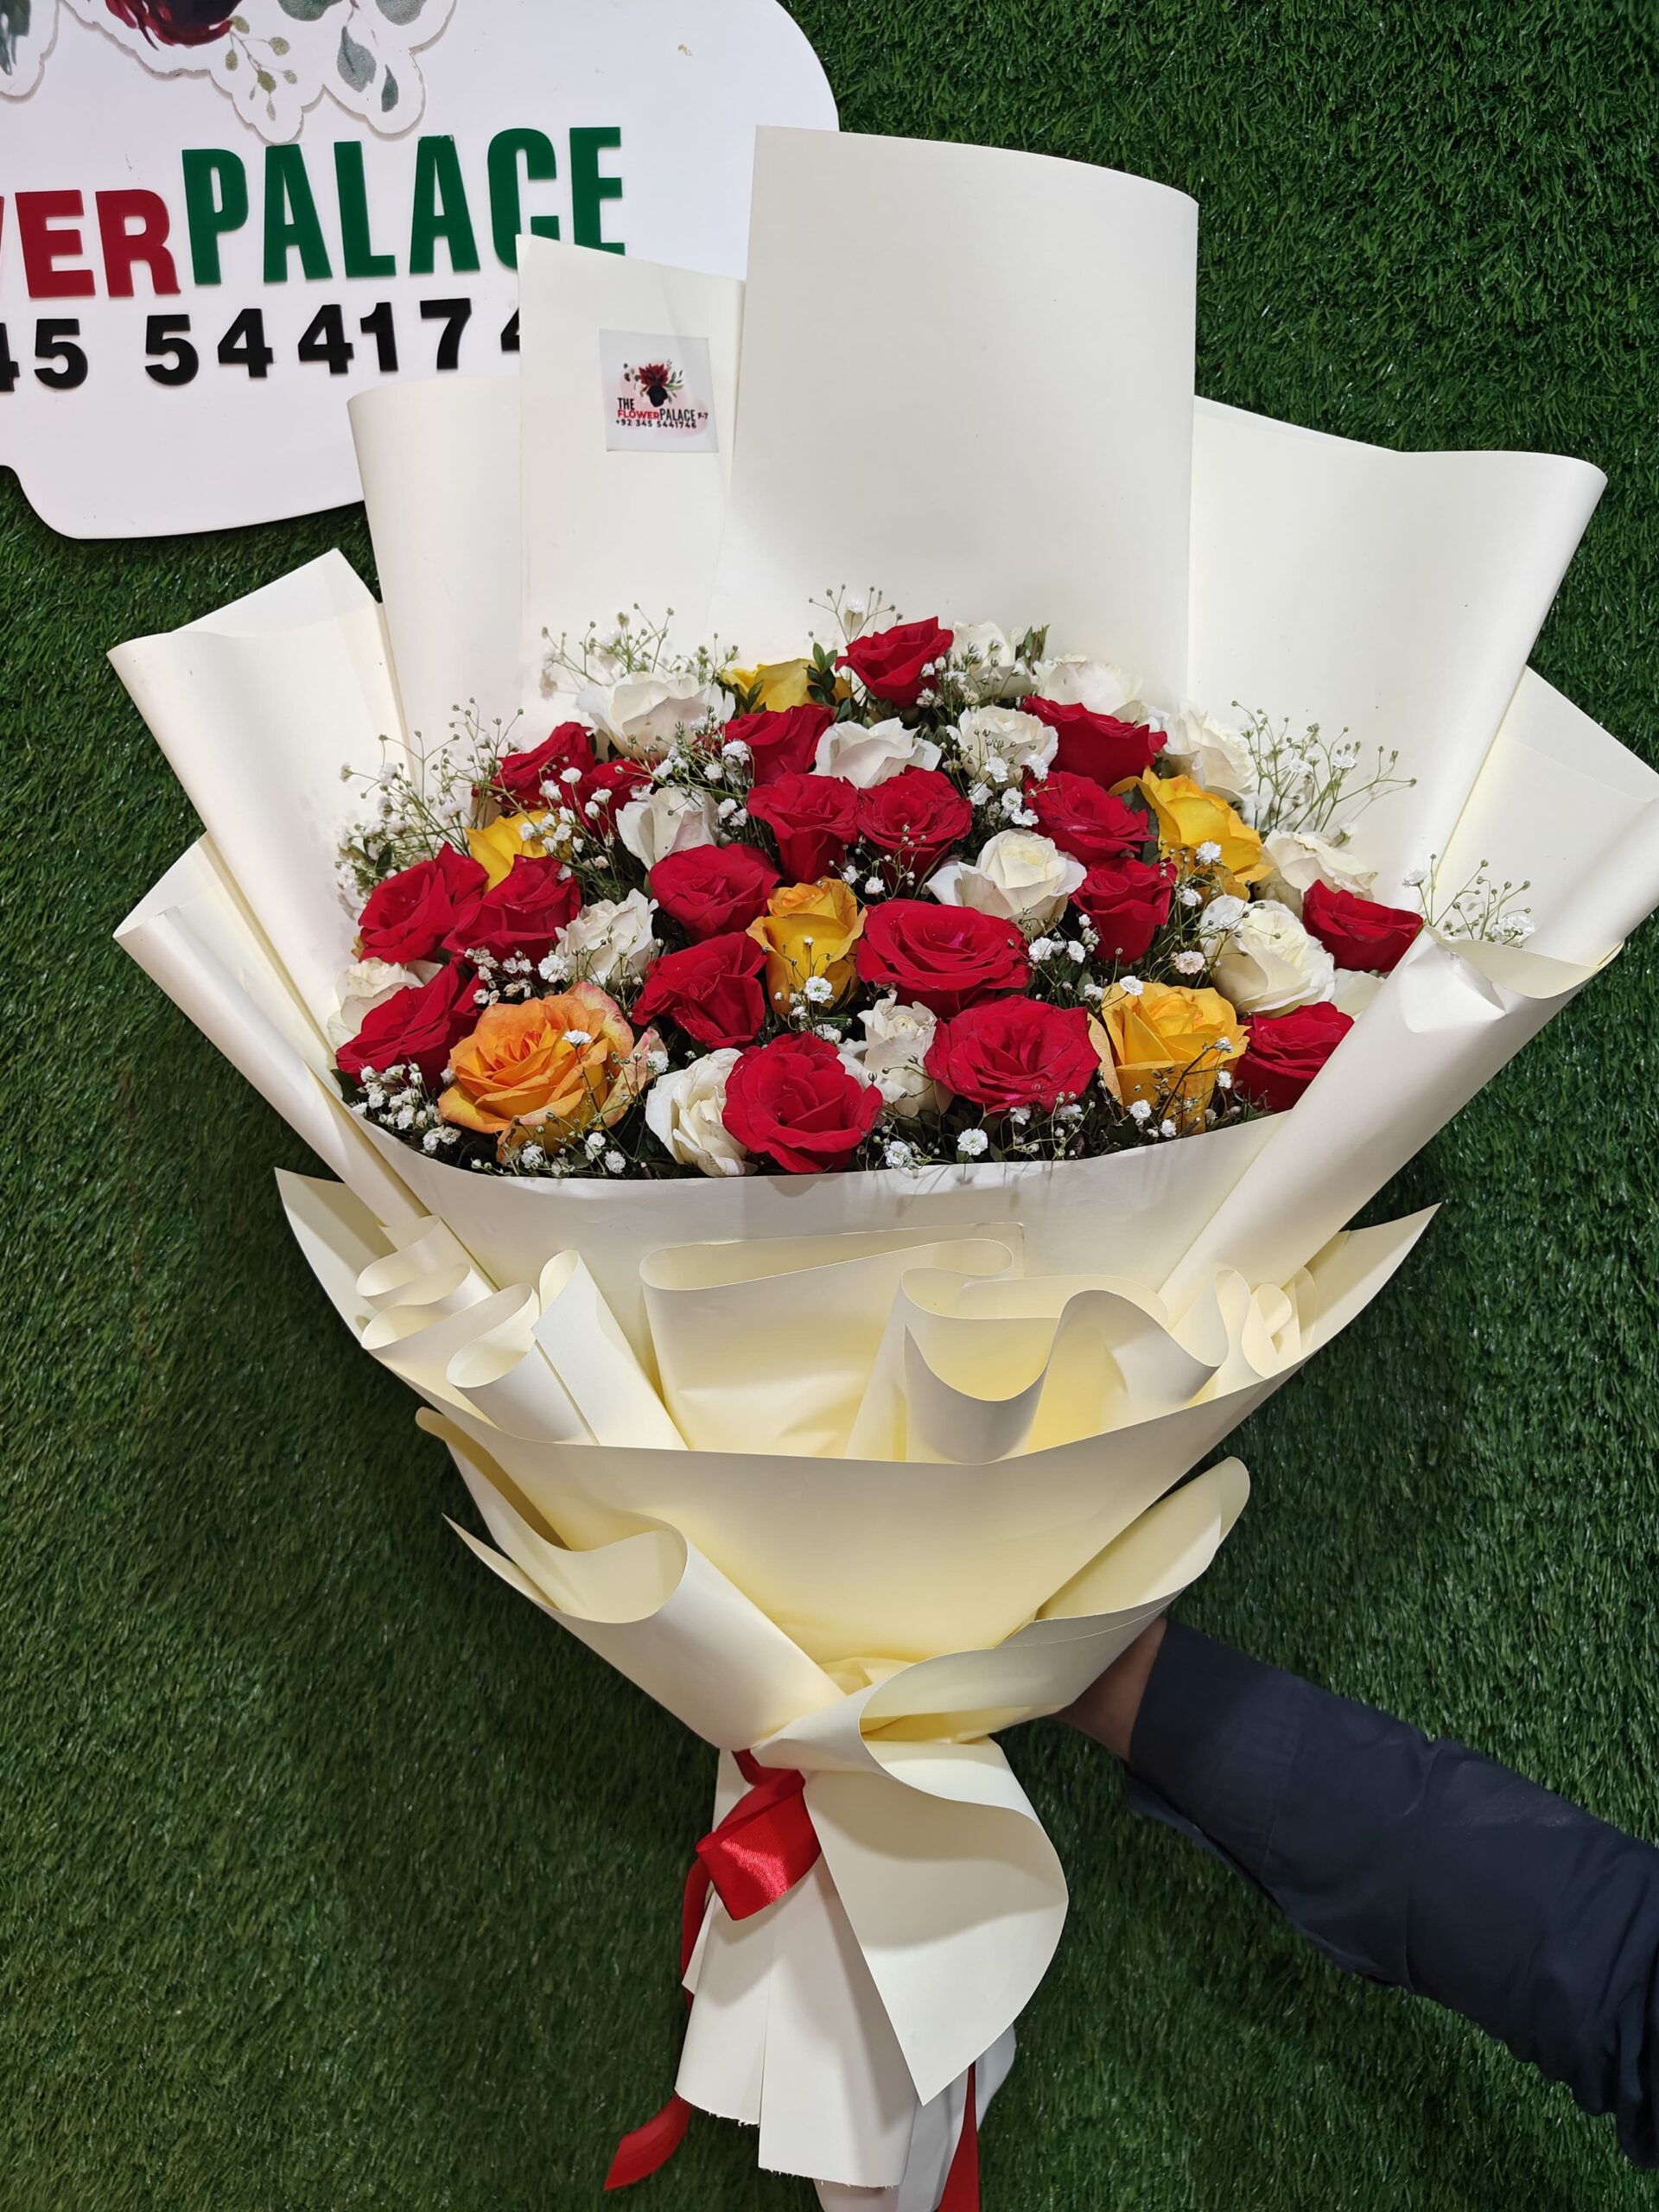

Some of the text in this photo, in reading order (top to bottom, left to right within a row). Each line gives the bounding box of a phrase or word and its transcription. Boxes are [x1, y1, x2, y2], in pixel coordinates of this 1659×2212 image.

[0, 126, 626, 298] ER PALACE
[145, 297, 519, 387] 54417
[617, 397, 635, 410] THE
[635, 419, 653, 428] 345
[657, 420, 697, 429] 5441746
